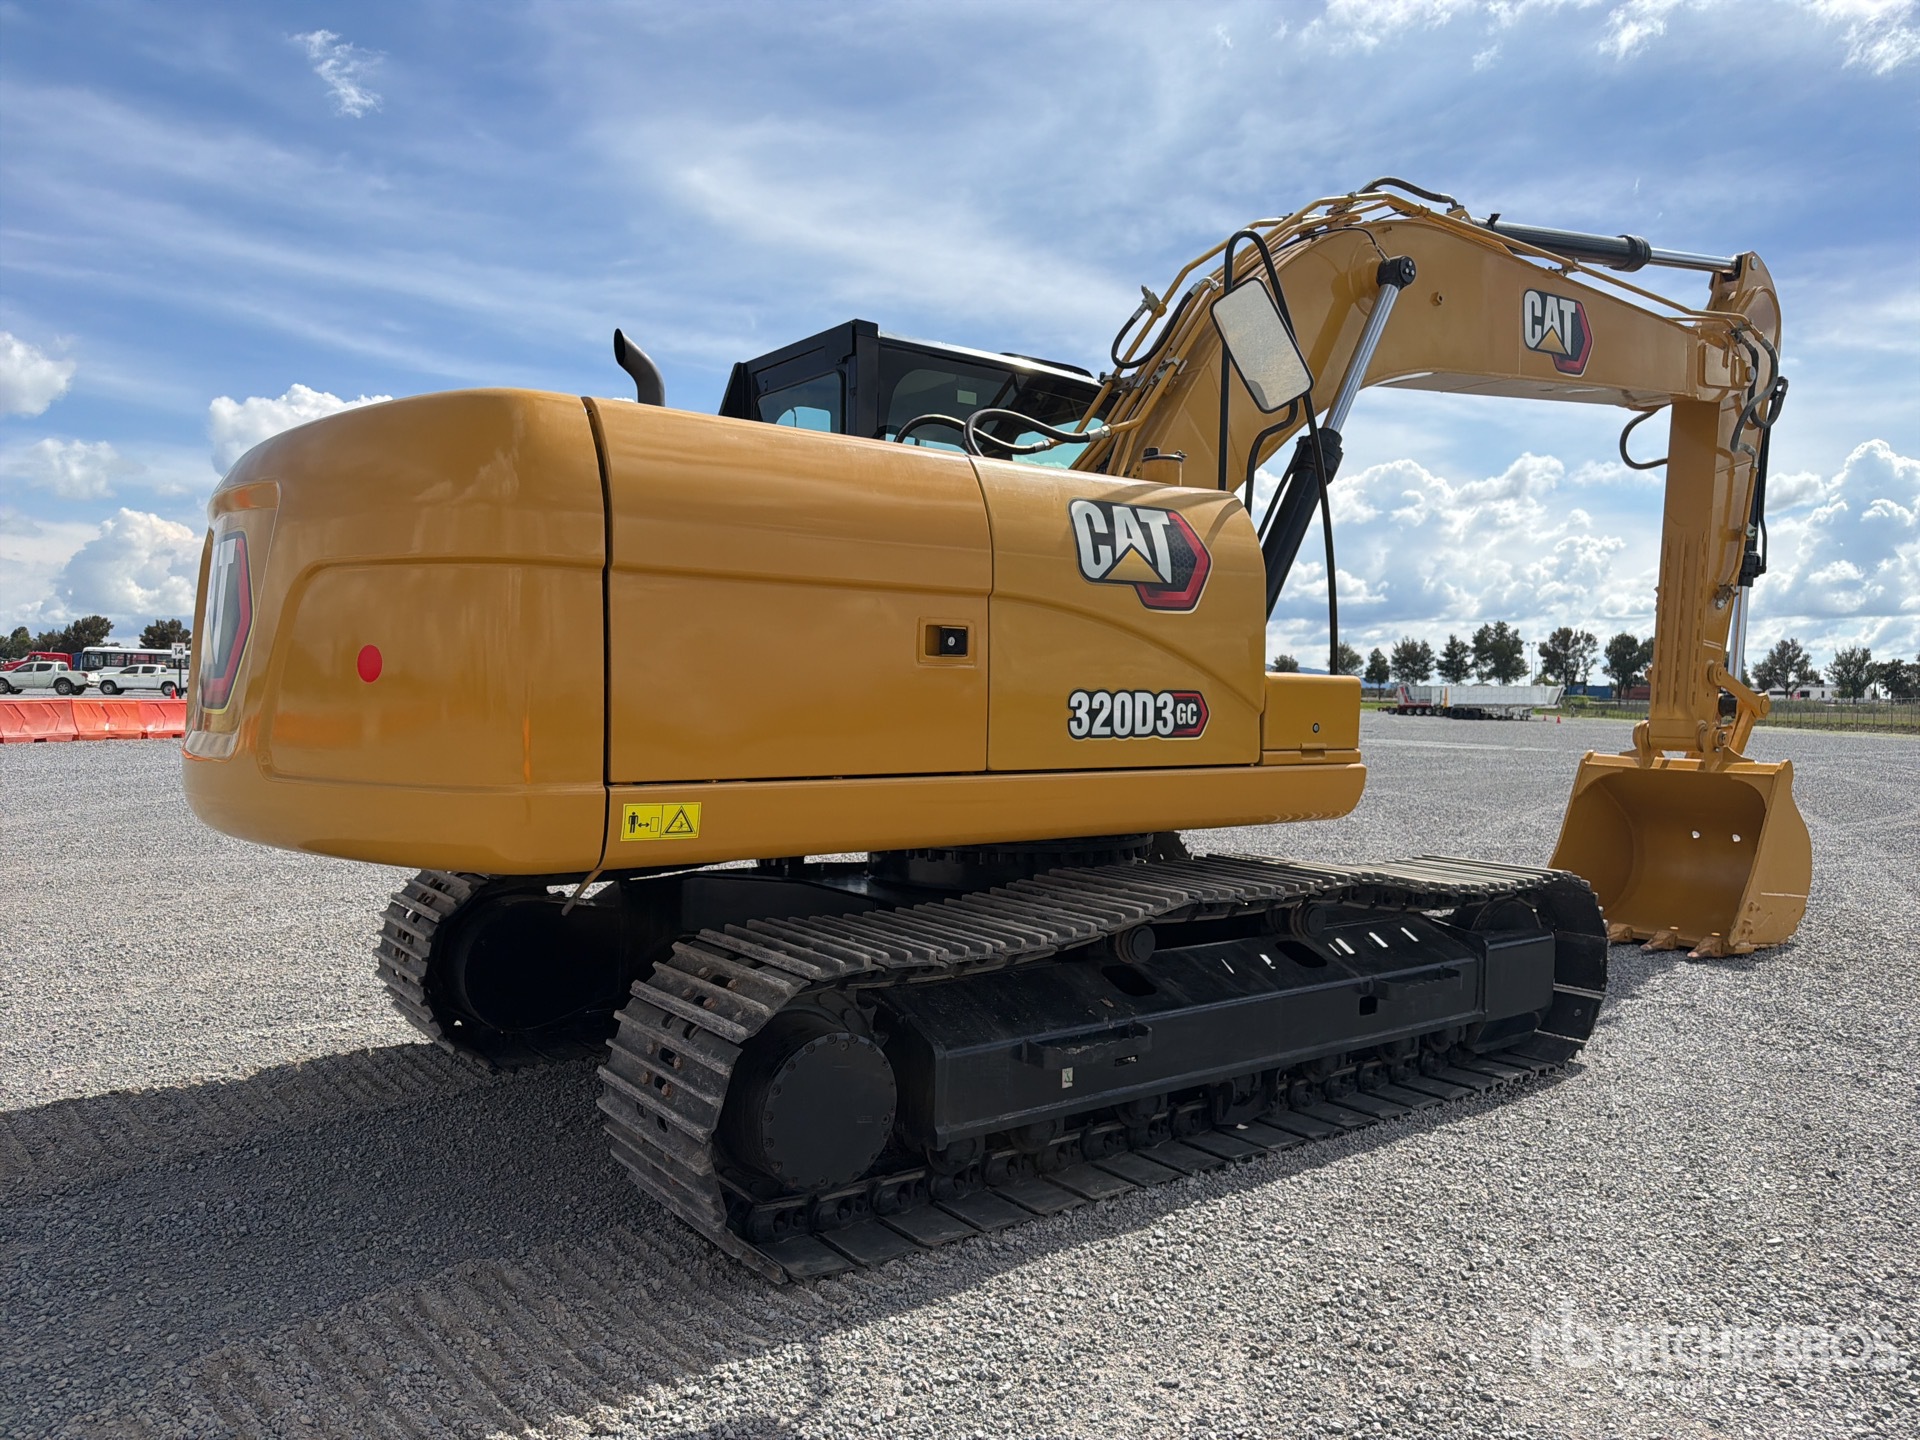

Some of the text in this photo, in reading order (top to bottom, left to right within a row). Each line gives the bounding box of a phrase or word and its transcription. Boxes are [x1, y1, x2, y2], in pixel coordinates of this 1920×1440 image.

[1524, 290, 1576, 356] CAT
[1071, 500, 1172, 584] CAT
[173, 647, 184, 656] 14
[1069, 691, 1198, 736] 320D3 GC
